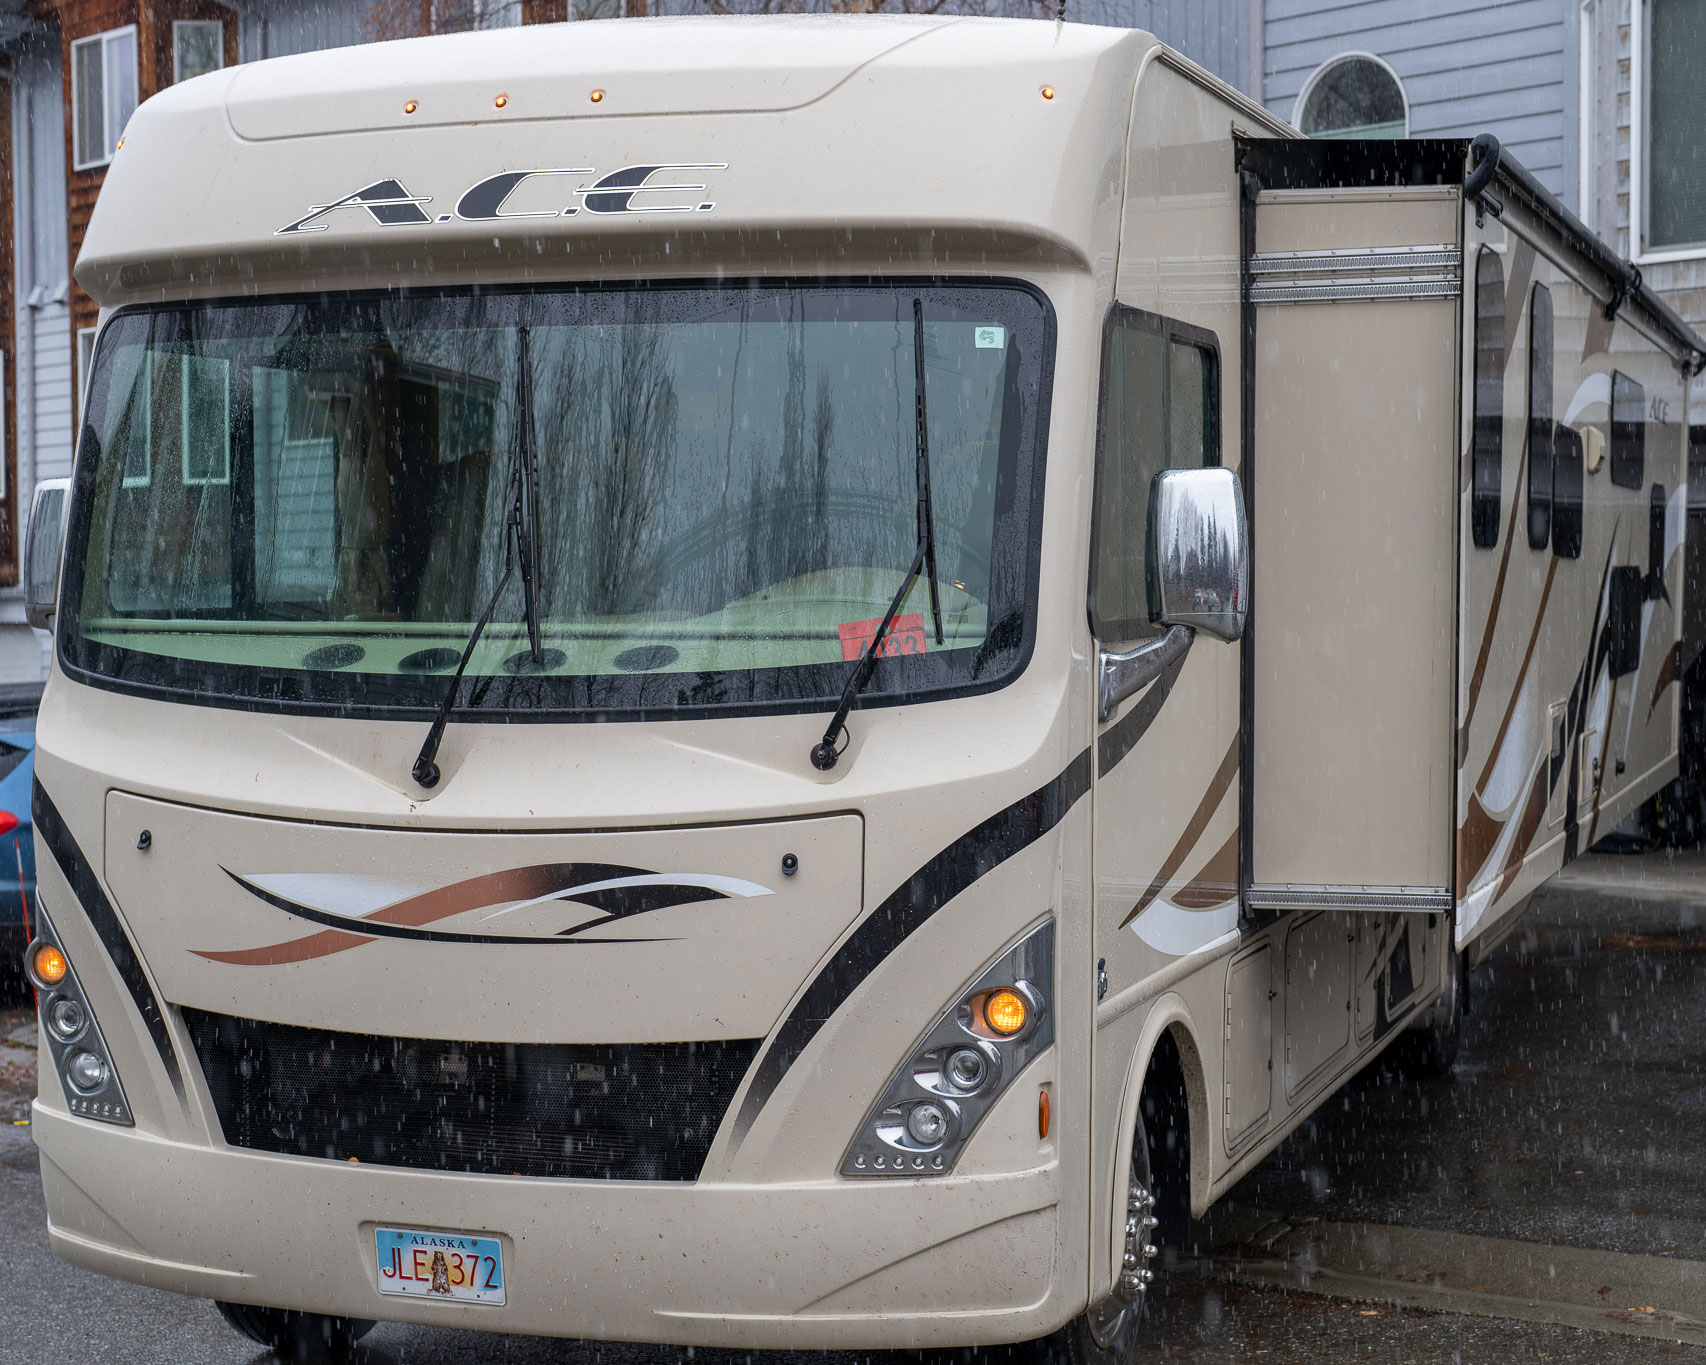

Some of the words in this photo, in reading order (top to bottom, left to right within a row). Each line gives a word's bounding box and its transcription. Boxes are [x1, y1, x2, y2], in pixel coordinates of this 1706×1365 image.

[274, 163, 729, 235] A.C.E.
[411, 1236, 466, 1249] ALASKA
[382, 1247, 430, 1282] JLE
[451, 1252, 498, 1289] 372
